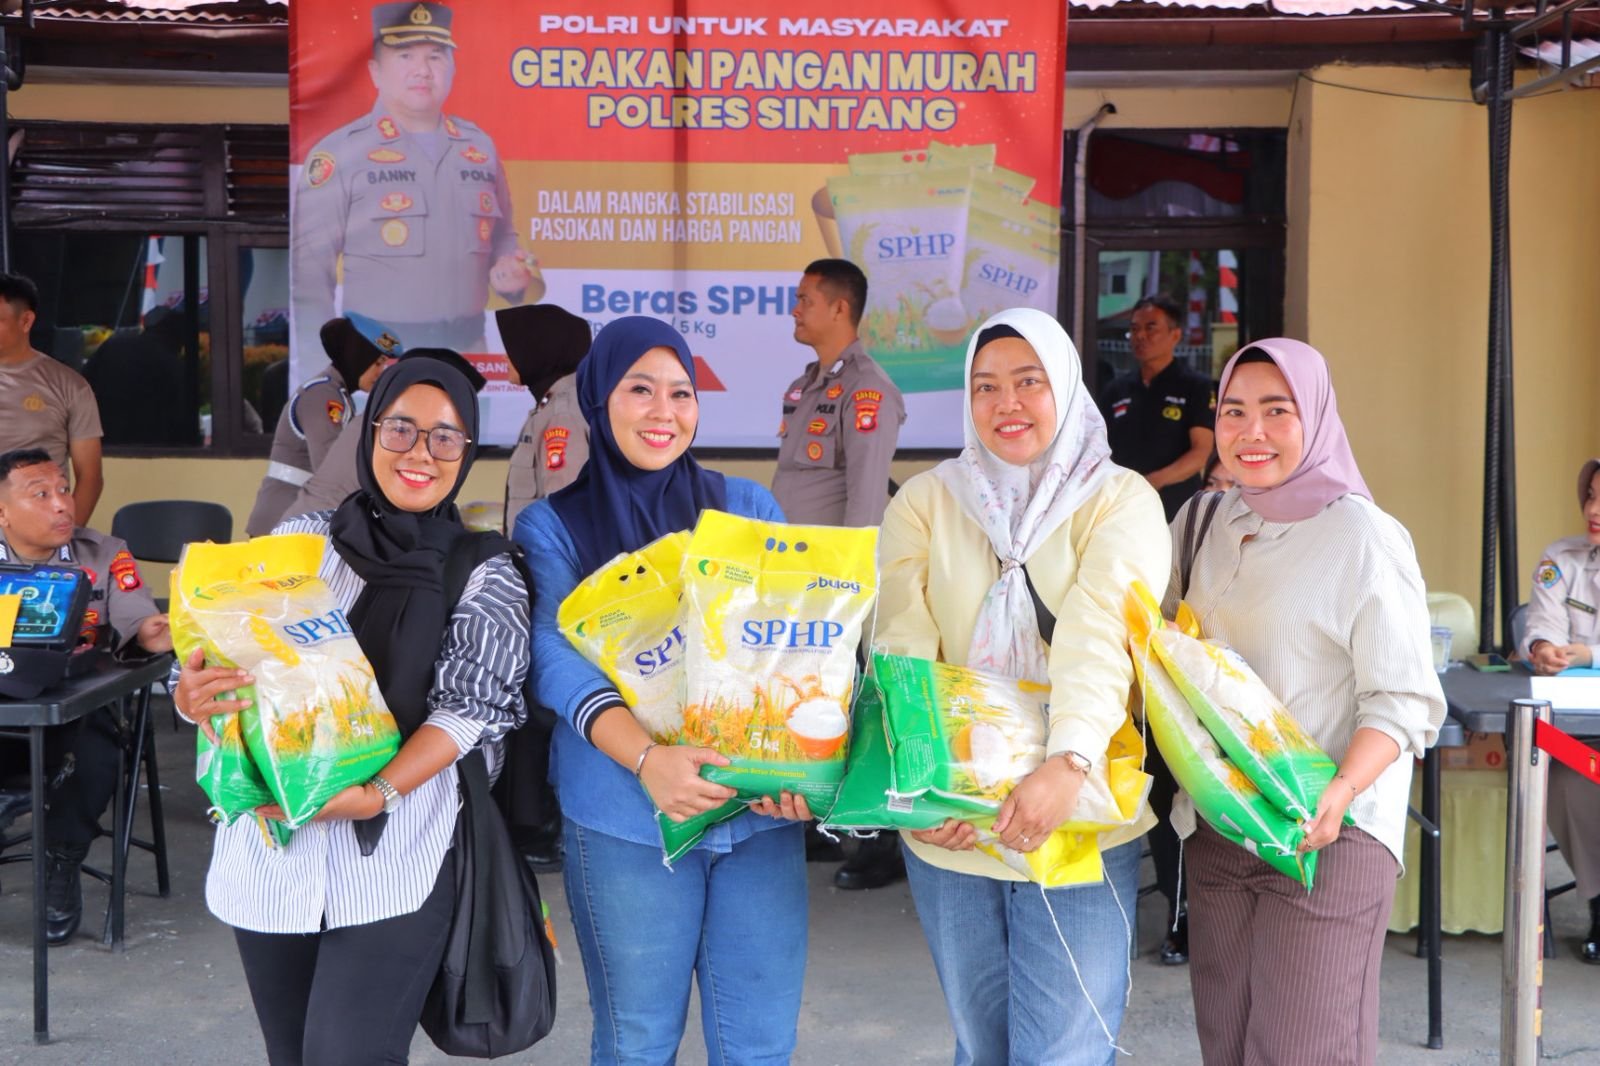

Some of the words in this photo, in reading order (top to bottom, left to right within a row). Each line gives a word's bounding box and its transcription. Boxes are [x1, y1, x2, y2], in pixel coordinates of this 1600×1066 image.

[540, 15, 639, 35] POLRI
[648, 16, 767, 37] UNTUK
[779, 17, 1009, 38] MASYARAKAT
[510, 47, 703, 90] GERAKAN
[709, 50, 884, 92] PANGAN
[887, 51, 1036, 93] MURAH
[587, 95, 751, 130] POLRES
[756, 96, 959, 131] SINTANG
[538, 191, 601, 214] DALAM
[608, 191, 681, 215] RANGKA
[686, 192, 795, 216] STABILISASI
[530, 218, 615, 242] PASOKAN
[620, 219, 657, 242] DAN
[662, 219, 723, 243] HARGA
[729, 220, 802, 244] PANGAN
[878, 233, 955, 259] SPHP
[979, 263, 1038, 295] SPHP
[582, 284, 698, 314] Beras
[681, 320, 690, 334] 5
[694, 321, 716, 339] Kg
[284, 608, 353, 645] SPH
[741, 619, 844, 648] SPHP
[351, 720, 361, 738] 5
[749, 732, 762, 749] 5
[763, 737, 780, 753] kg
